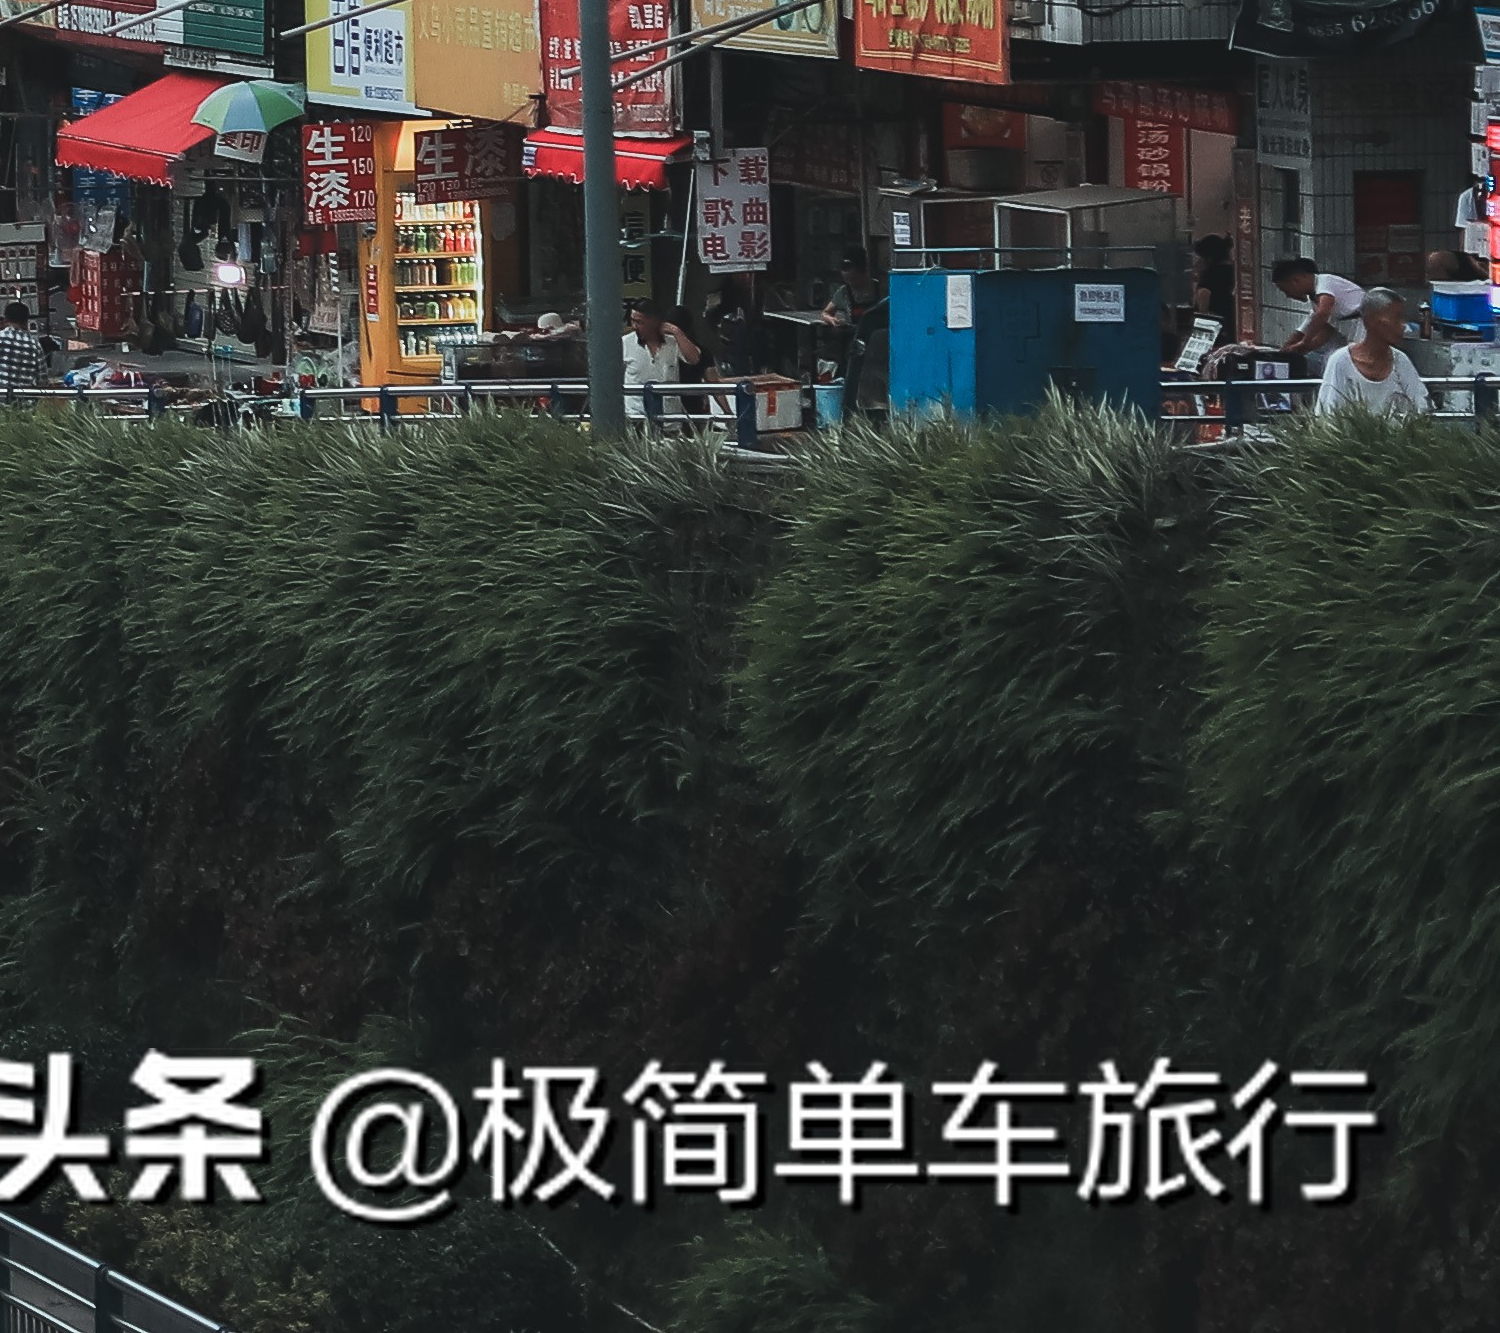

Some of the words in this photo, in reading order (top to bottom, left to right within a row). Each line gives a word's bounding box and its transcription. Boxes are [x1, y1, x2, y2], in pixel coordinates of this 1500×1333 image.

[350, 125, 373, 144] 120
[305, 126, 351, 210] 生漆
[351, 157, 374, 175] 150
[416, 130, 508, 181] 生漆
[1135, 120, 1172, 193] 汤砂锅粉
[352, 190, 376, 209] 170
[703, 196, 770, 229] 歌曲
[702, 231, 769, 261] 电影
